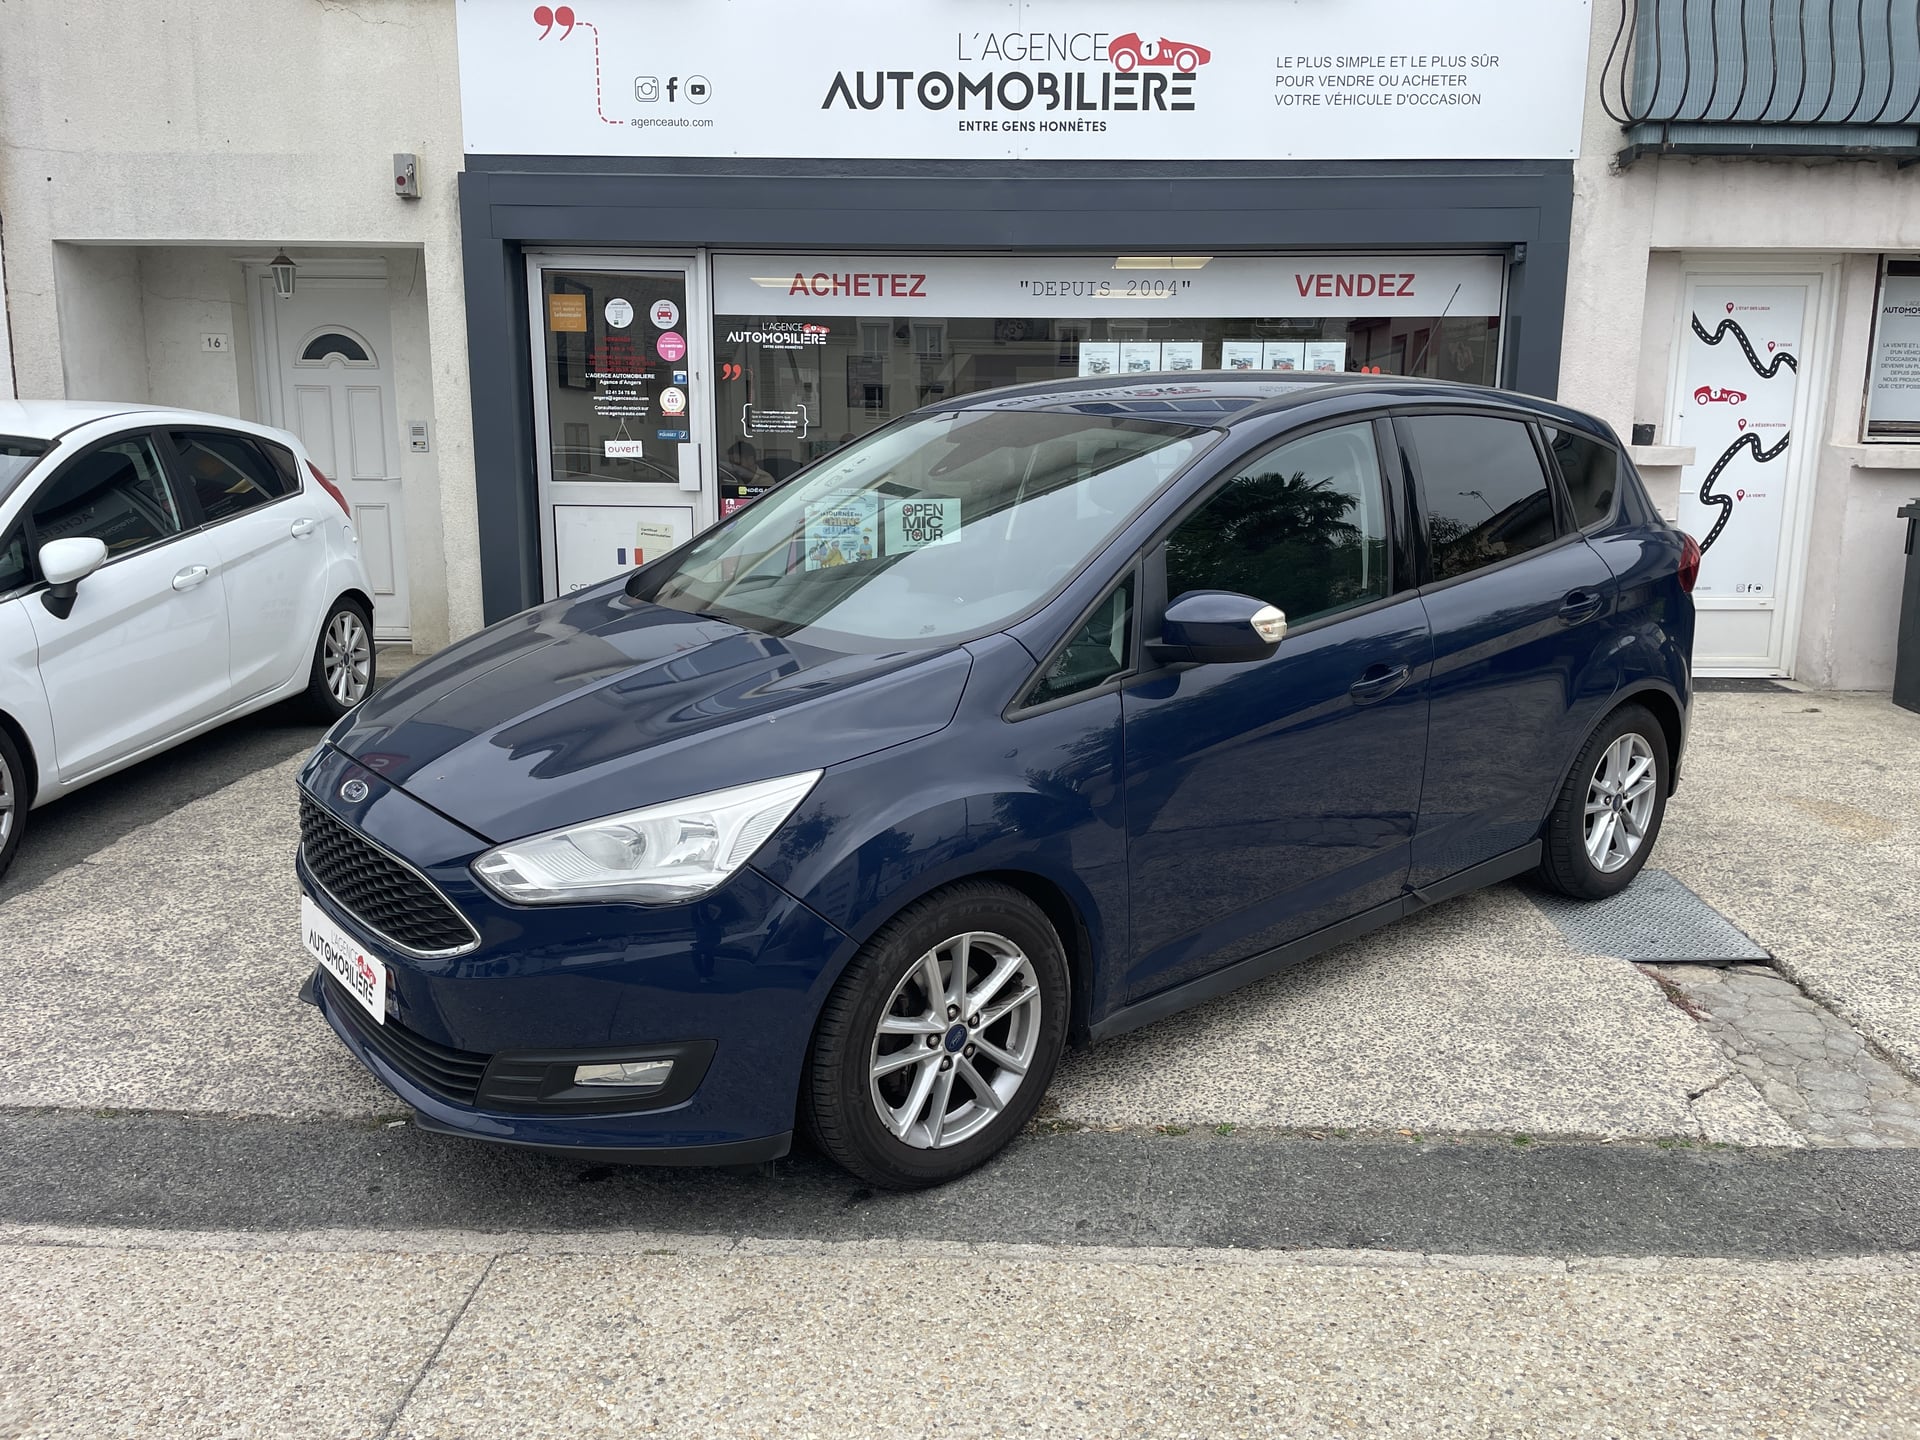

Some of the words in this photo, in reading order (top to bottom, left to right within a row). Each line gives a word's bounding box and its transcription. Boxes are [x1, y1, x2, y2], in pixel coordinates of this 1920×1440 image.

[958, 32, 1109, 61] L'AGENCE
[1276, 56, 1293, 68] LE
[1297, 56, 1332, 68] PLUS
[1336, 56, 1385, 68] SIMPLE
[1390, 56, 1405, 67] ET
[1411, 56, 1427, 67] LE
[1431, 55, 1467, 67] PLUS
[1470, 53, 1499, 67] SÛR
[1275, 75, 1314, 87] POUR
[1319, 75, 1375, 87] VENDRE
[1378, 75, 1399, 87] OU
[1402, 75, 1467, 86] ACHETER
[1274, 94, 1320, 106] VOTRE
[1325, 91, 1392, 106] VÉHICULE
[1397, 94, 1482, 105] D'OCCASION
[630, 115, 714, 129] agenceauto.com
[958, 120, 999, 132] ENTRE
[1002, 120, 1036, 132] GENS
[1039, 117, 1107, 132] HONNÊTES
[789, 273, 927, 297] ACHETEZ
[1020, 280, 1111, 297] "DEPUIS
[1127, 279, 1191, 297] 2004"
[1295, 273, 1416, 297] VENDEZ
[762, 322, 803, 331] L'AGENCE
[207, 337, 221, 348] 16
[608, 445, 640, 453] ouvert
[902, 503, 944, 517] OPEN
[902, 516, 943, 528] MIC
[902, 528, 944, 542] TOUR
